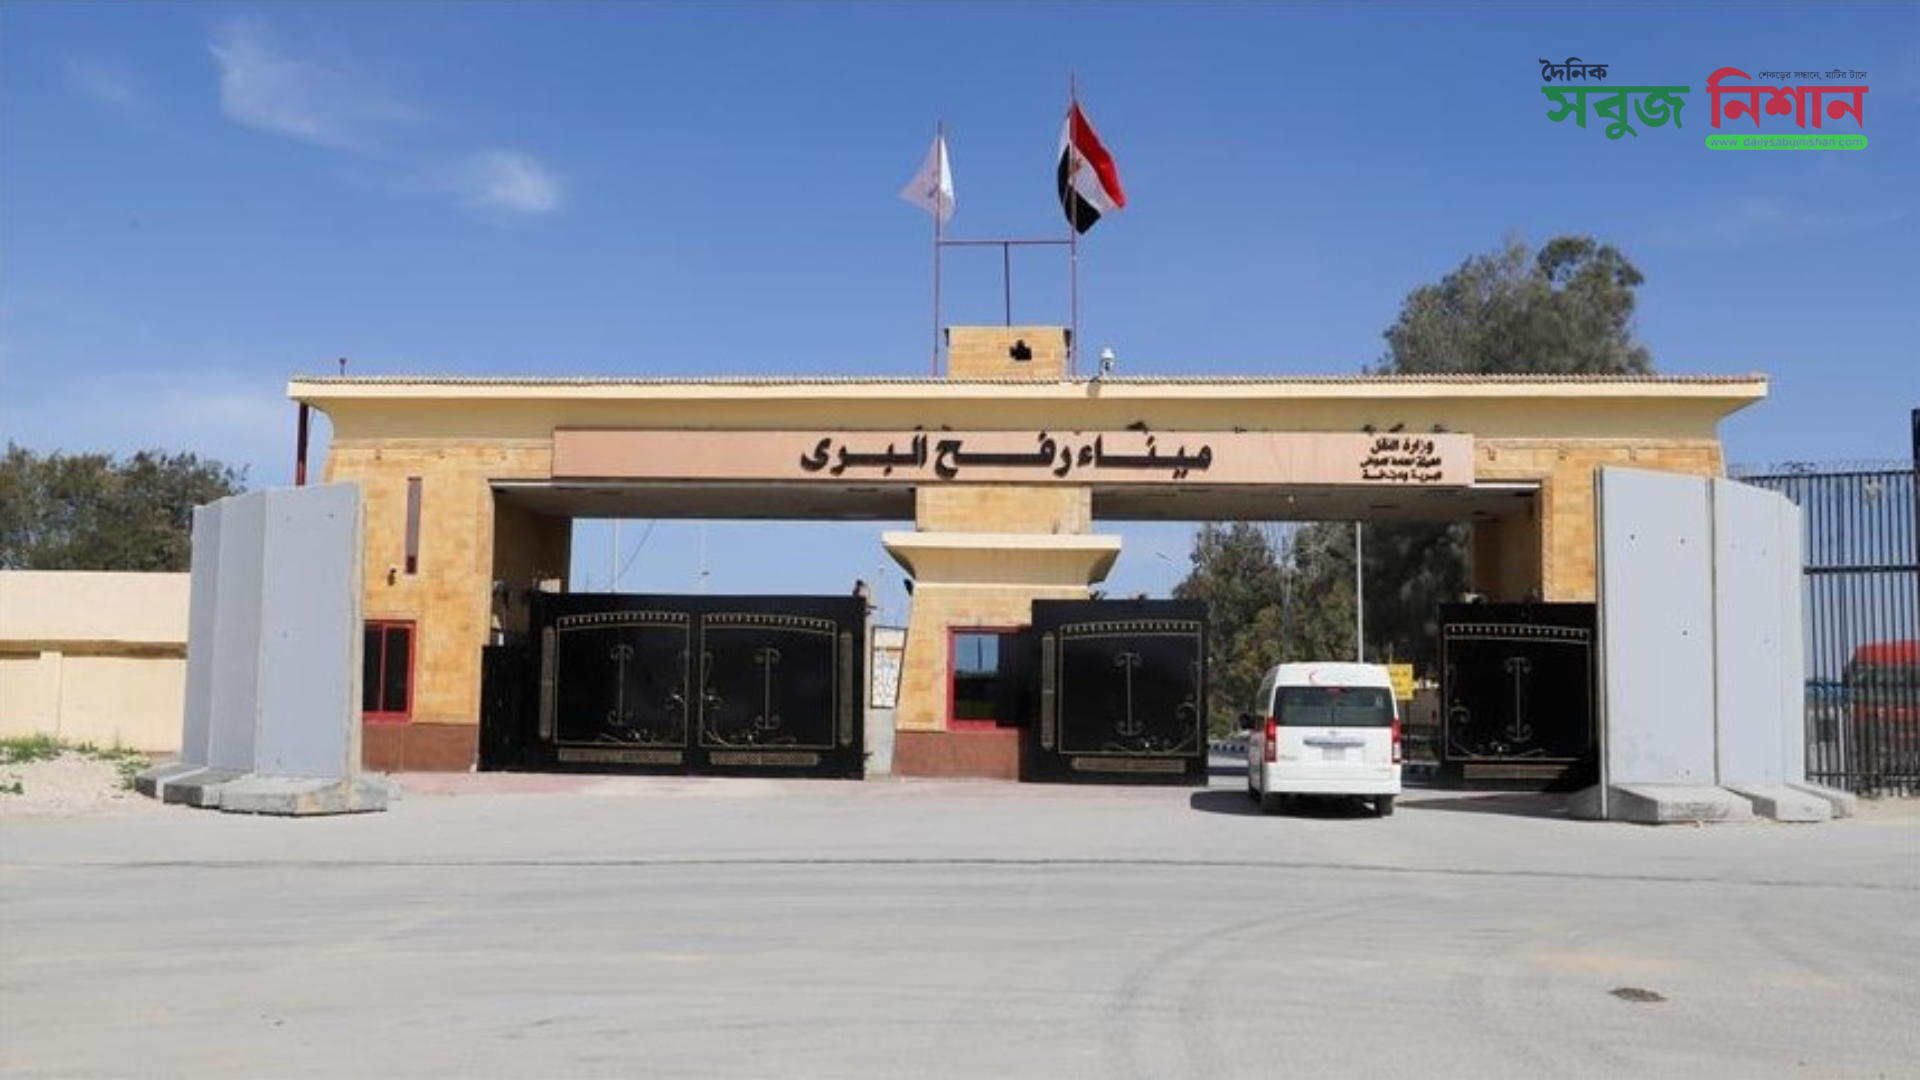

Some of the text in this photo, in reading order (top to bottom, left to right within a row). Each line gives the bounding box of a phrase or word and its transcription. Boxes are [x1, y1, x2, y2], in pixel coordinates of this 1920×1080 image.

[935, 431, 1072, 480] رفح
[1077, 434, 1212, 479] ميناء
[1370, 437, 1434, 455] وزارة النقل
